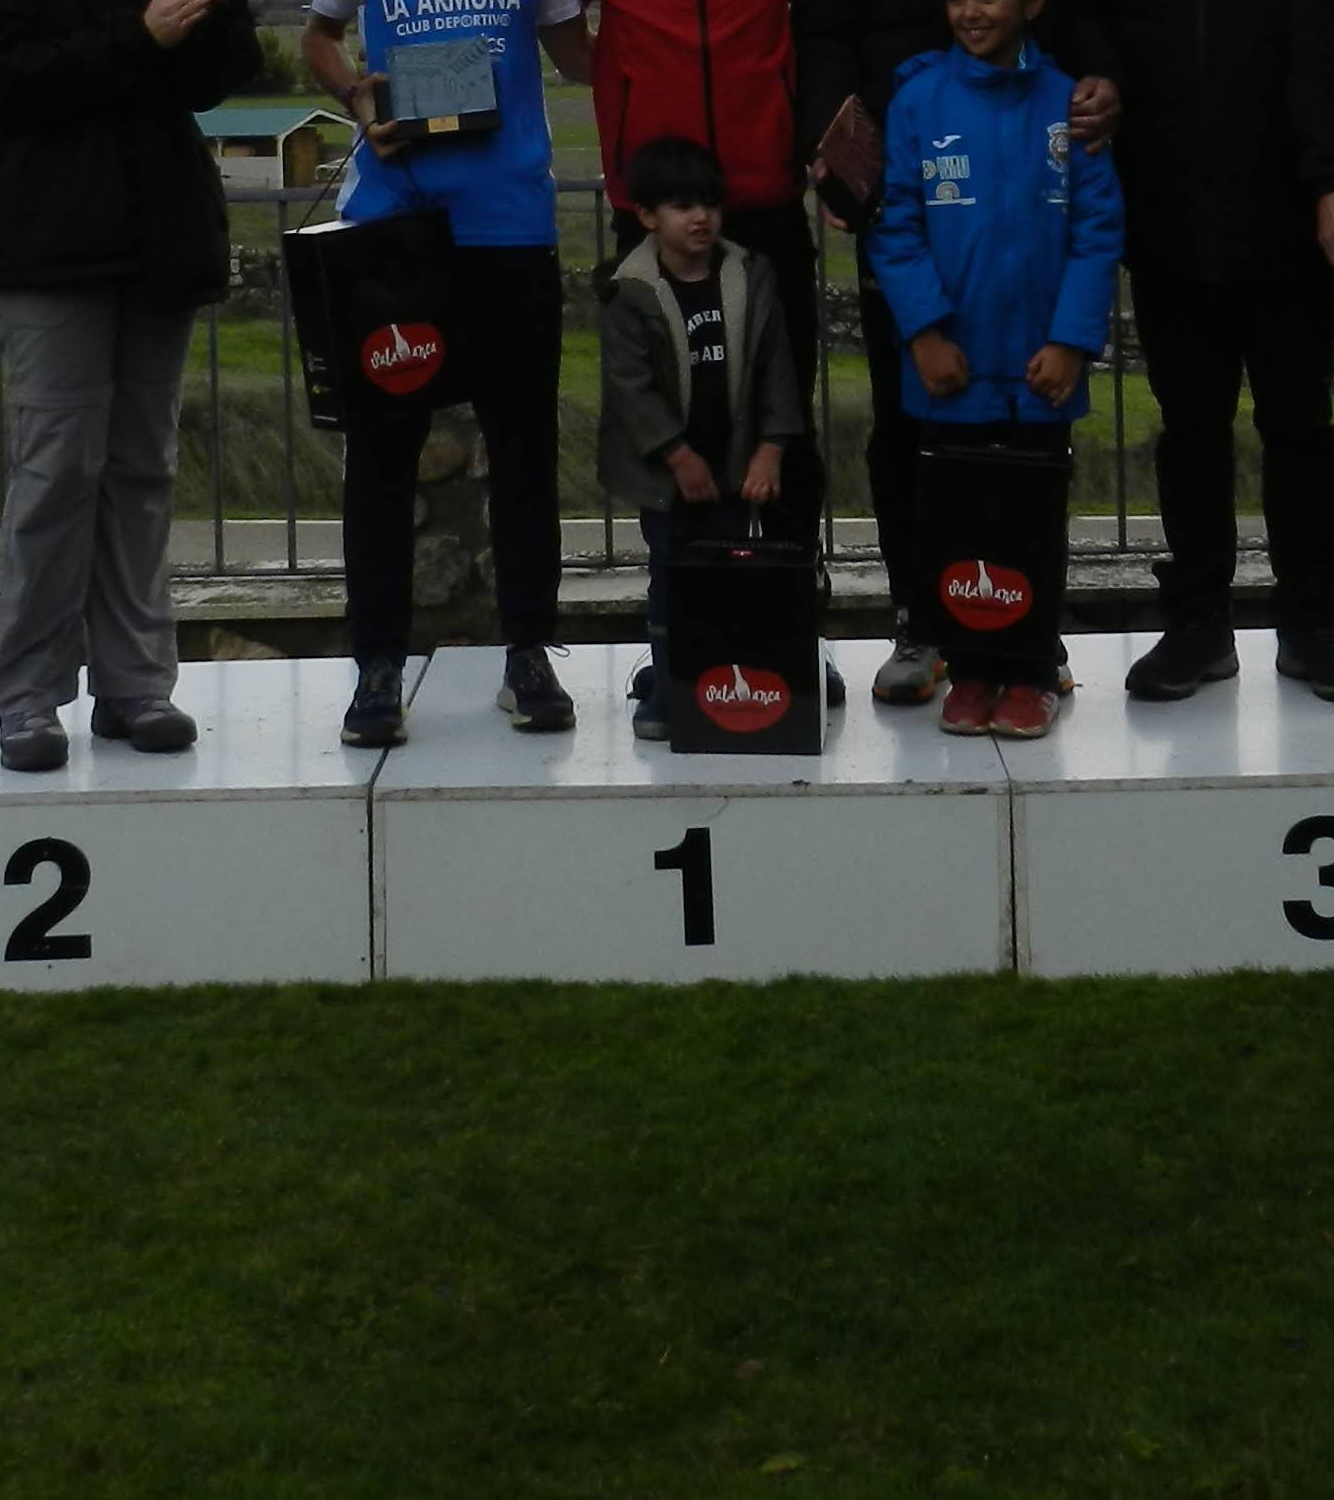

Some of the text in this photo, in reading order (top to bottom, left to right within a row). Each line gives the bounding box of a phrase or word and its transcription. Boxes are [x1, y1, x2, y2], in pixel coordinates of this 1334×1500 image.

[396, 13, 512, 37] CLUB DEPORTIVO
[3, 836, 92, 962] 2
[654, 826, 715, 946] 1
